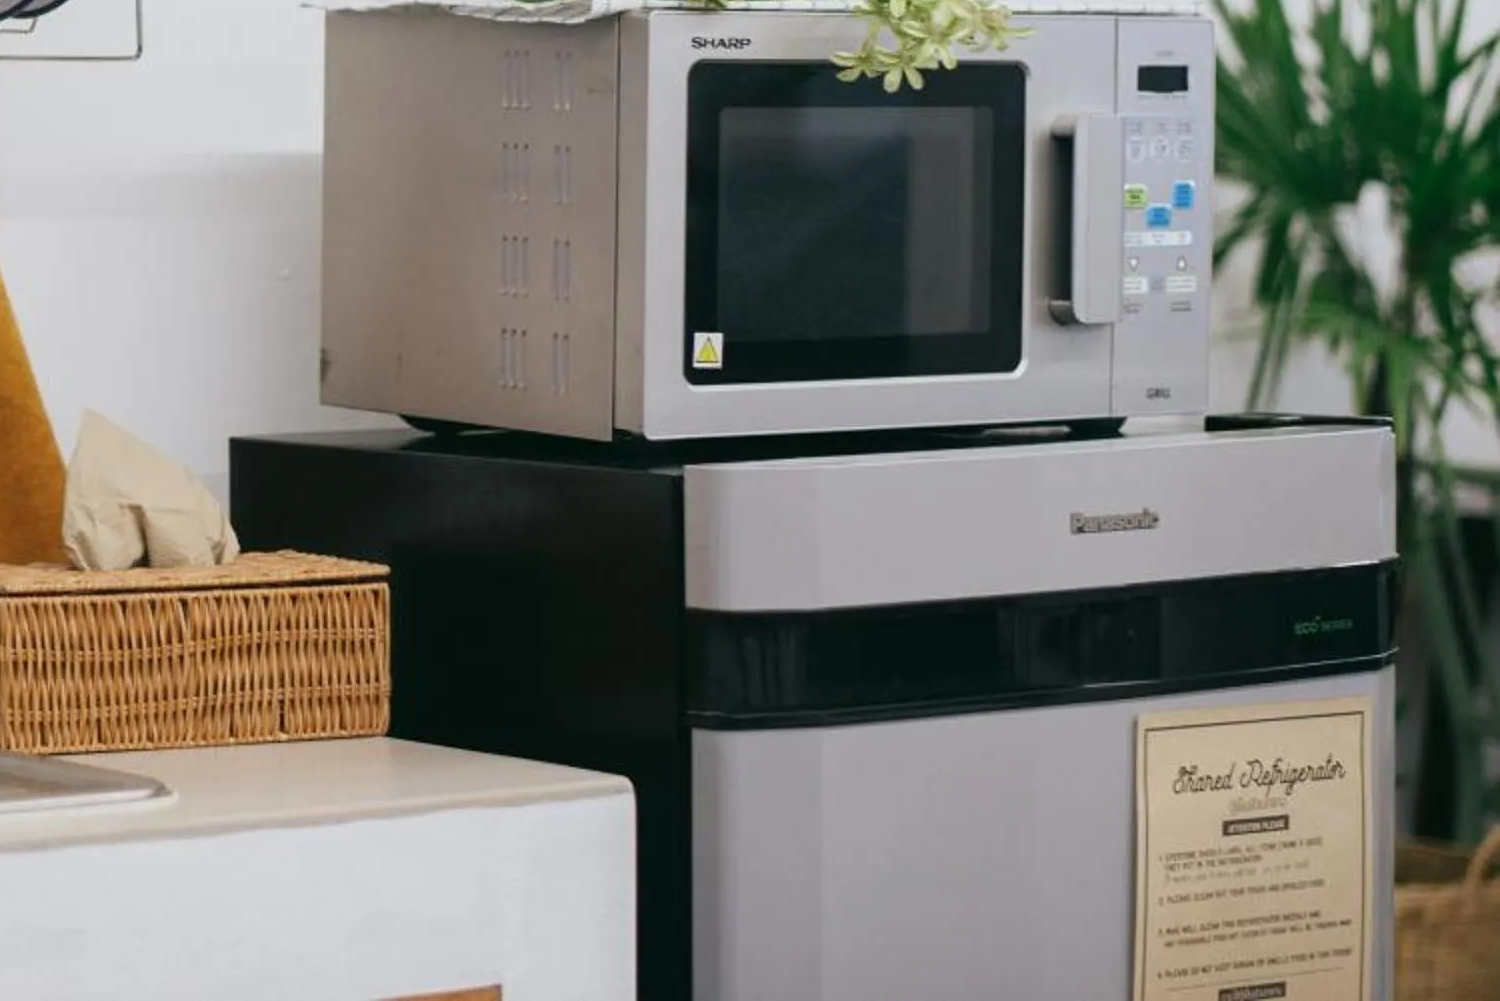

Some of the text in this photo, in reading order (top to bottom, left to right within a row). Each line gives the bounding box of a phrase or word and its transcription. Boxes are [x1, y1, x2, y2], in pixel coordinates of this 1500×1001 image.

[691, 36, 752, 50] SHARP
[1069, 507, 1160, 535] Panasonic
[1173, 752, 1346, 798] Shared Refrigerator
